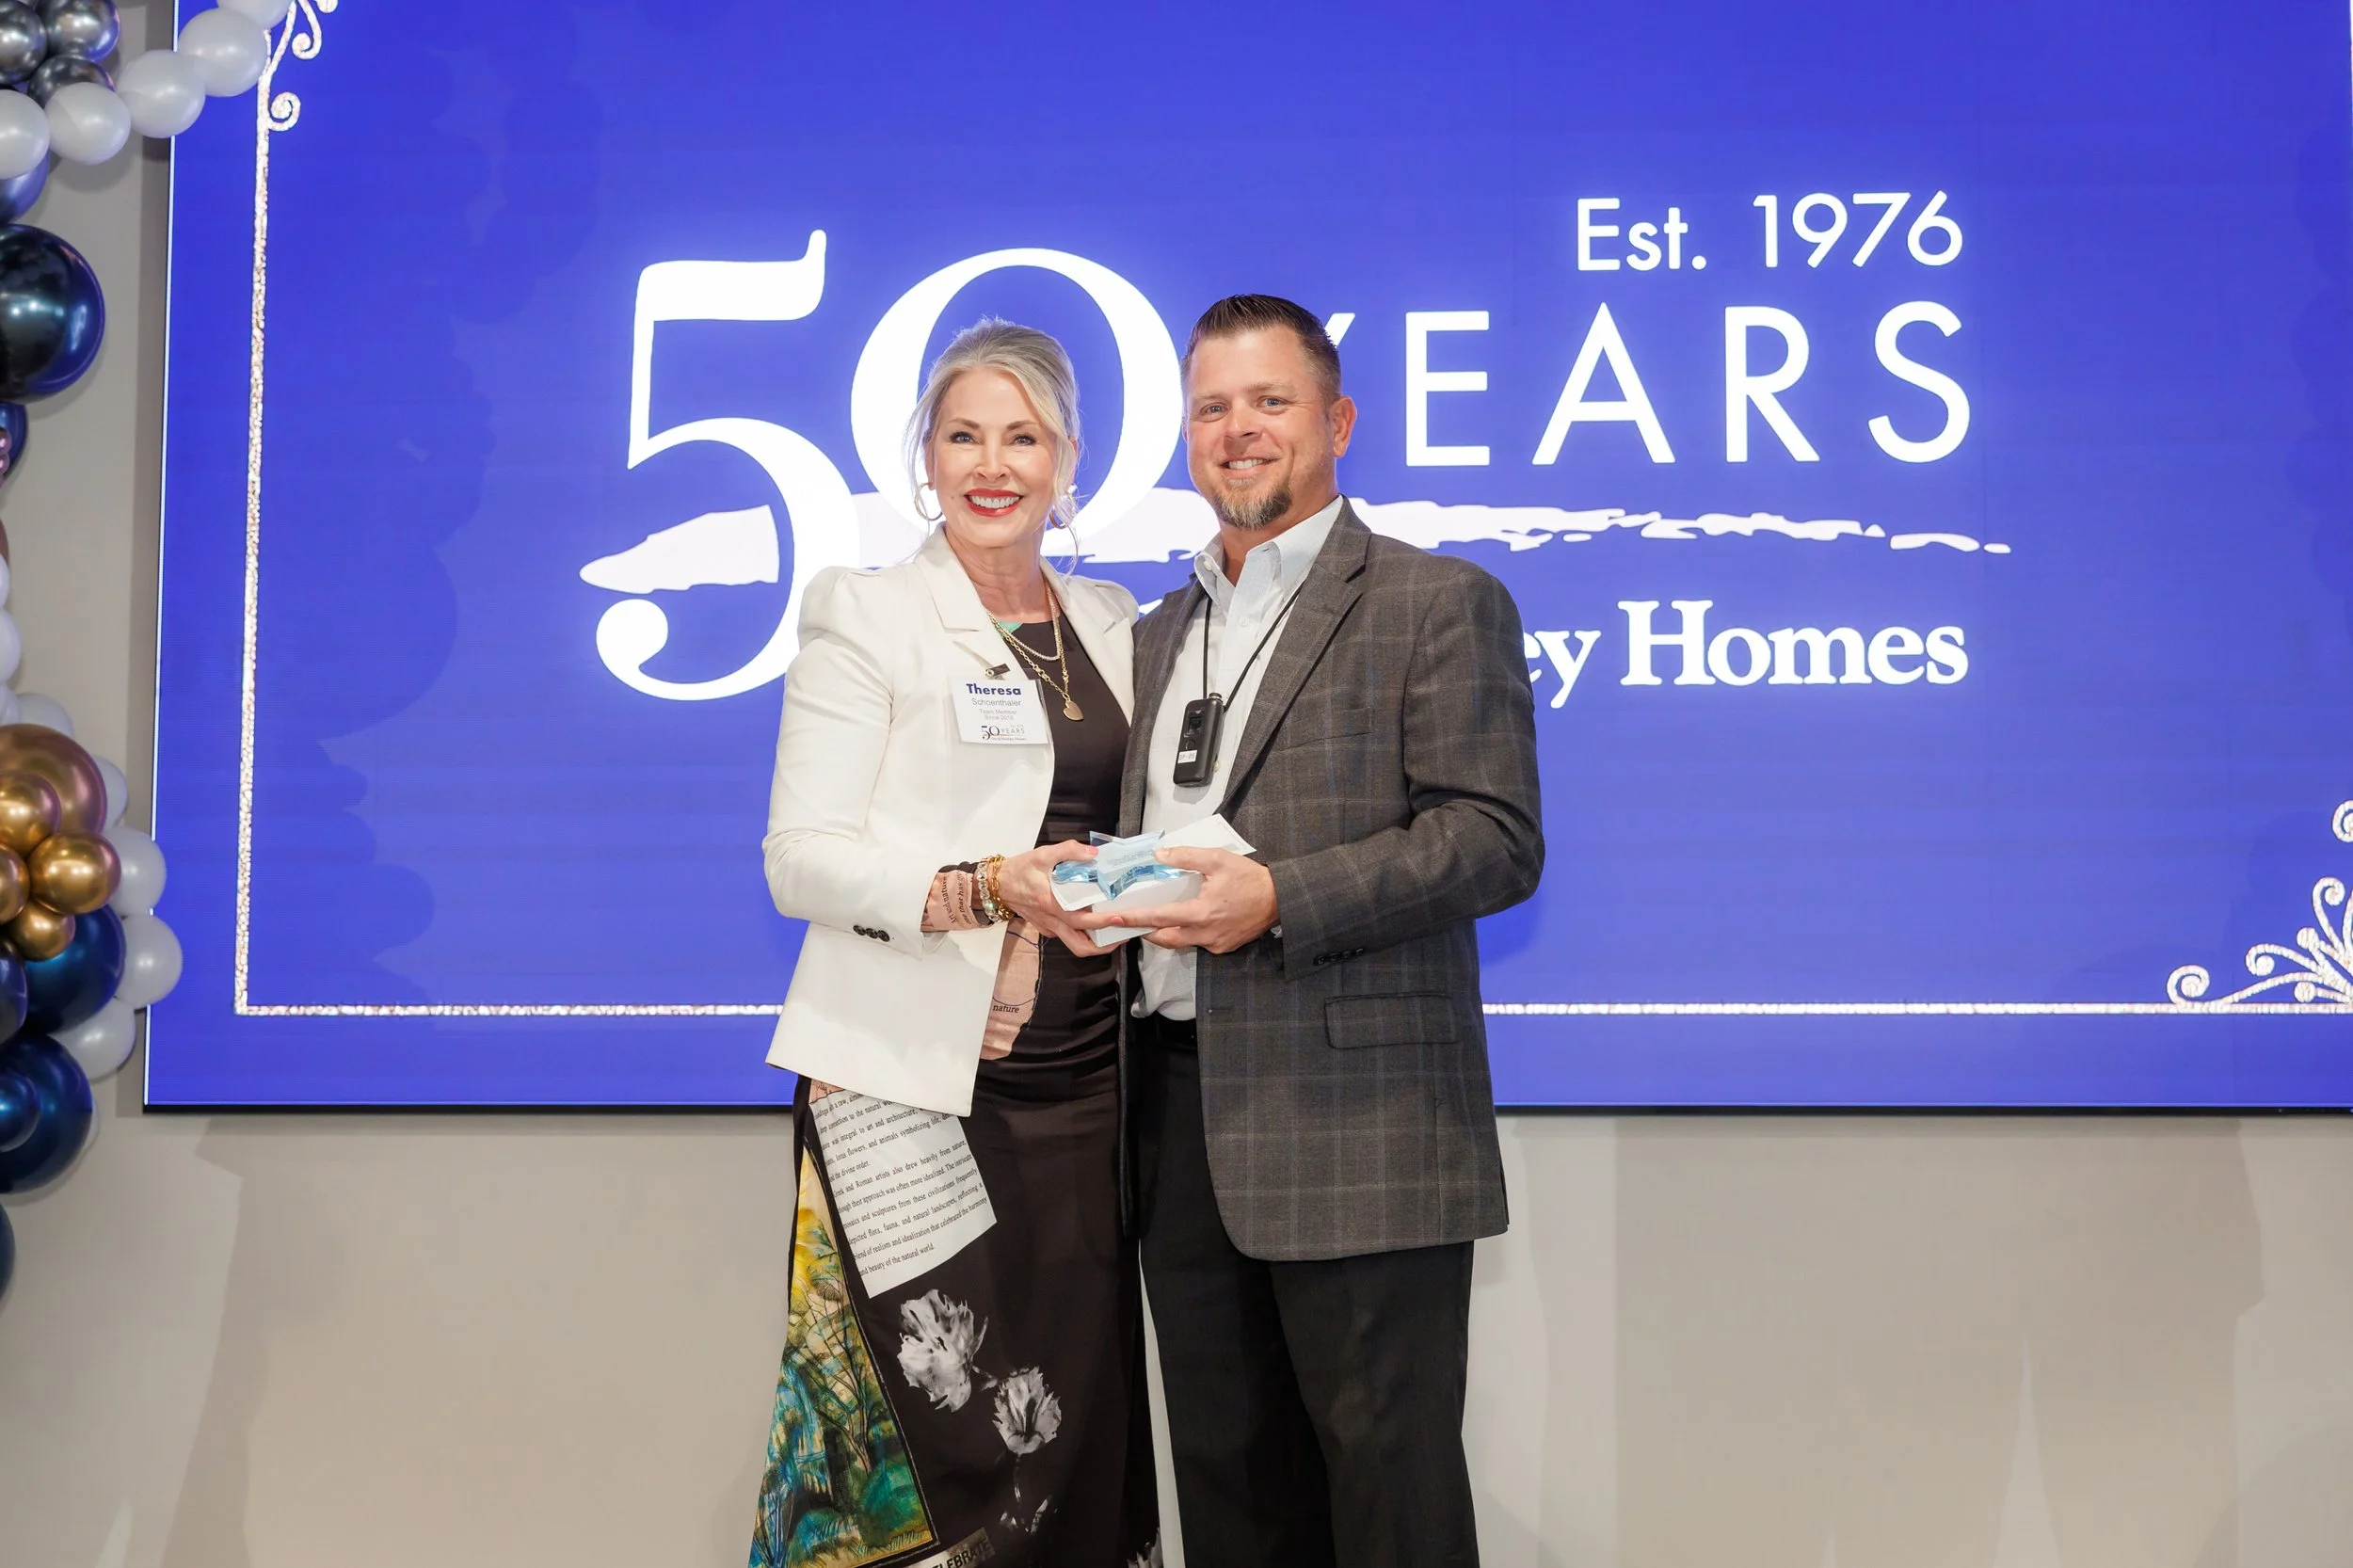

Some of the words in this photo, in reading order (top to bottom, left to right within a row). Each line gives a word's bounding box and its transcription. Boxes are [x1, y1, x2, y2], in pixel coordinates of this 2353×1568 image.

[1577, 198, 1706, 271] Est.
[1753, 190, 1963, 268] 1976
[594, 229, 1183, 701] 50
[1322, 300, 1970, 467] EARS
[1617, 600, 1969, 687] Homes
[966, 683, 1021, 695] Theresa
[981, 725, 1000, 740] 50
[941, 875, 950, 903] nature
[992, 1004, 1019, 1013] nature
[864, 1101, 881, 1113] natural
[868, 1139, 877, 1148] and
[879, 1132, 899, 1144] animals
[900, 1121, 931, 1137] symbolizing
[875, 1118, 885, 1128] and
[856, 1161, 871, 1170] order.
[856, 1177, 873, 1188] Roman
[875, 1170, 890, 1180] artists
[892, 1166, 903, 1175] also
[905, 1161, 918, 1171] drew
[920, 1153, 938, 1165] heavily
[939, 1148, 952, 1157] from
[861, 1212, 871, 1222] and
[872, 1205, 897, 1218] sculptures
[898, 1199, 911, 1208] from
[913, 1193, 926, 1203] these
[927, 1180, 954, 1198] civilizations
[955, 1168, 977, 1184] frequently
[863, 1190, 885, 1204] approach
[896, 1183, 909, 1192] often
[910, 1177, 922, 1186] more
[868, 1228, 882, 1237] flora,
[883, 1222, 900, 1231] fauna,
[902, 1216, 911, 1224] and
[913, 1208, 930, 1221] natural
[931, 1198, 957, 1213] landscapes,
[958, 1186, 978, 1200] reflecting
[867, 1246, 872, 1255] of
[873, 1242, 891, 1254] realism
[891, 1237, 902, 1246] and
[901, 1228, 930, 1242] idealization
[968, 1197, 987, 1211] harmony
[868, 1261, 885, 1272] beauty
[886, 1258, 891, 1267] of
[892, 1256, 901, 1264] the
[901, 1248, 919, 1260] natural
